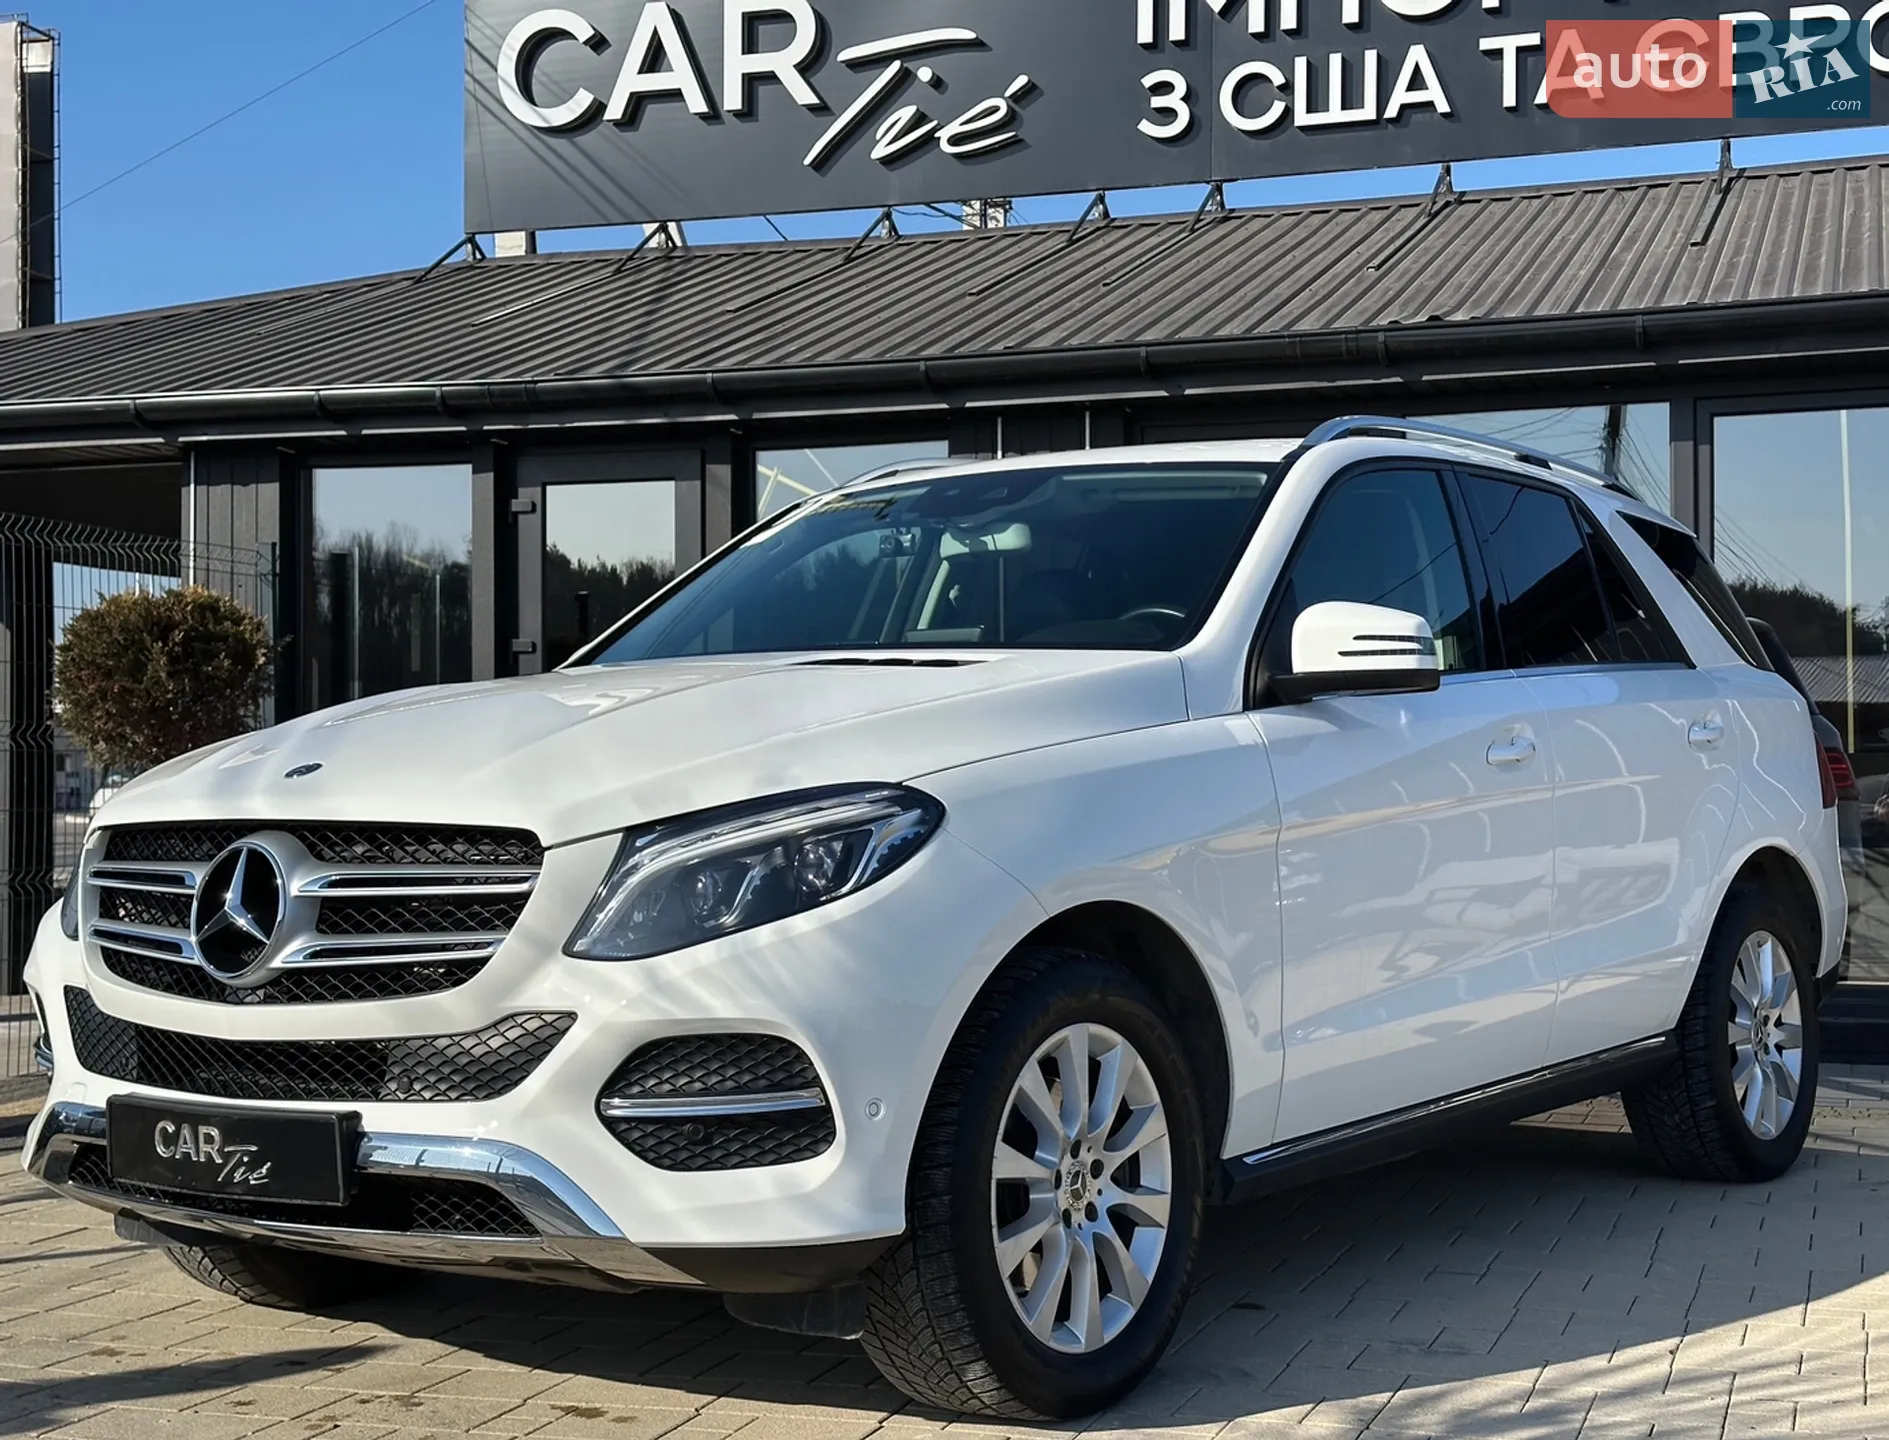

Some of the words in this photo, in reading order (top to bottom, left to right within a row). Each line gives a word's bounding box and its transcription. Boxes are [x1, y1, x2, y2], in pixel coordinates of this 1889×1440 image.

[497, 0, 821, 129] CAR
[1218, 43, 1451, 132] США
[154, 1119, 223, 1164] CAR
